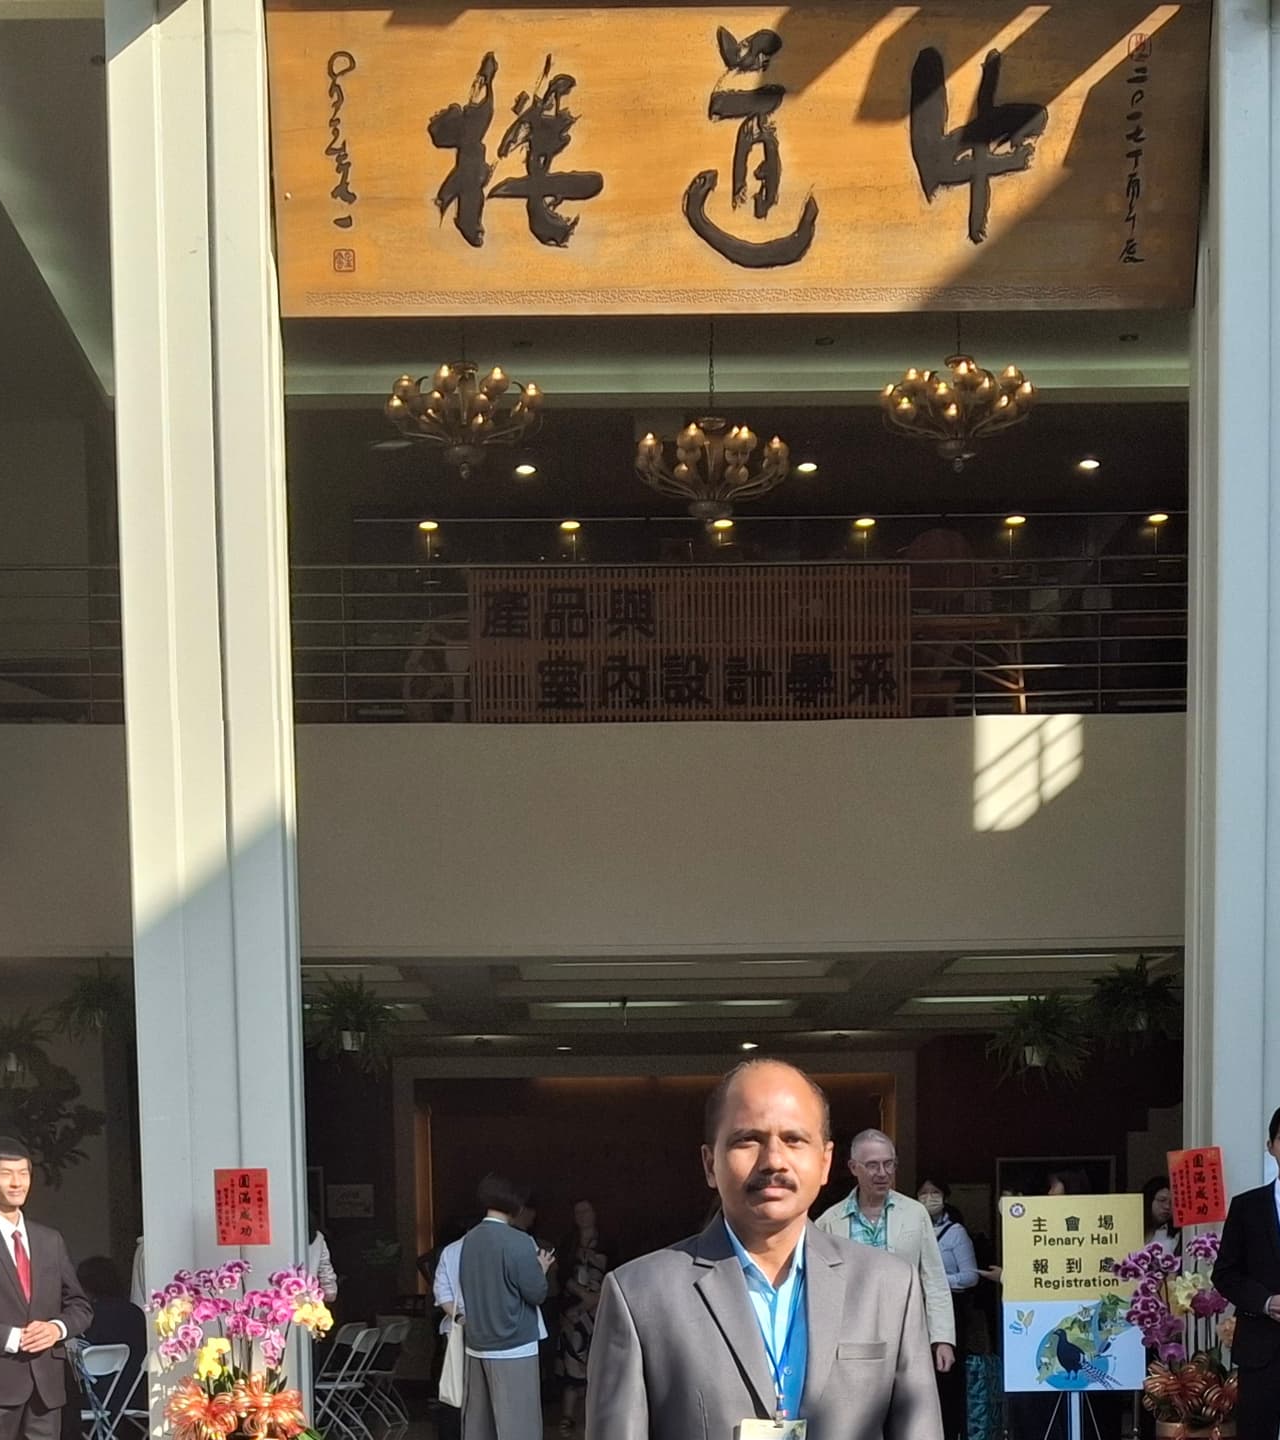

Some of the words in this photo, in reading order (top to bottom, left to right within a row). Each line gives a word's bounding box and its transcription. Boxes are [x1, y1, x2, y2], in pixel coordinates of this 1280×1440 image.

[1033, 1234, 1085, 1247] Plenary
[1091, 1233, 1119, 1245] Hall
[1033, 1276, 1120, 1290] Registration
